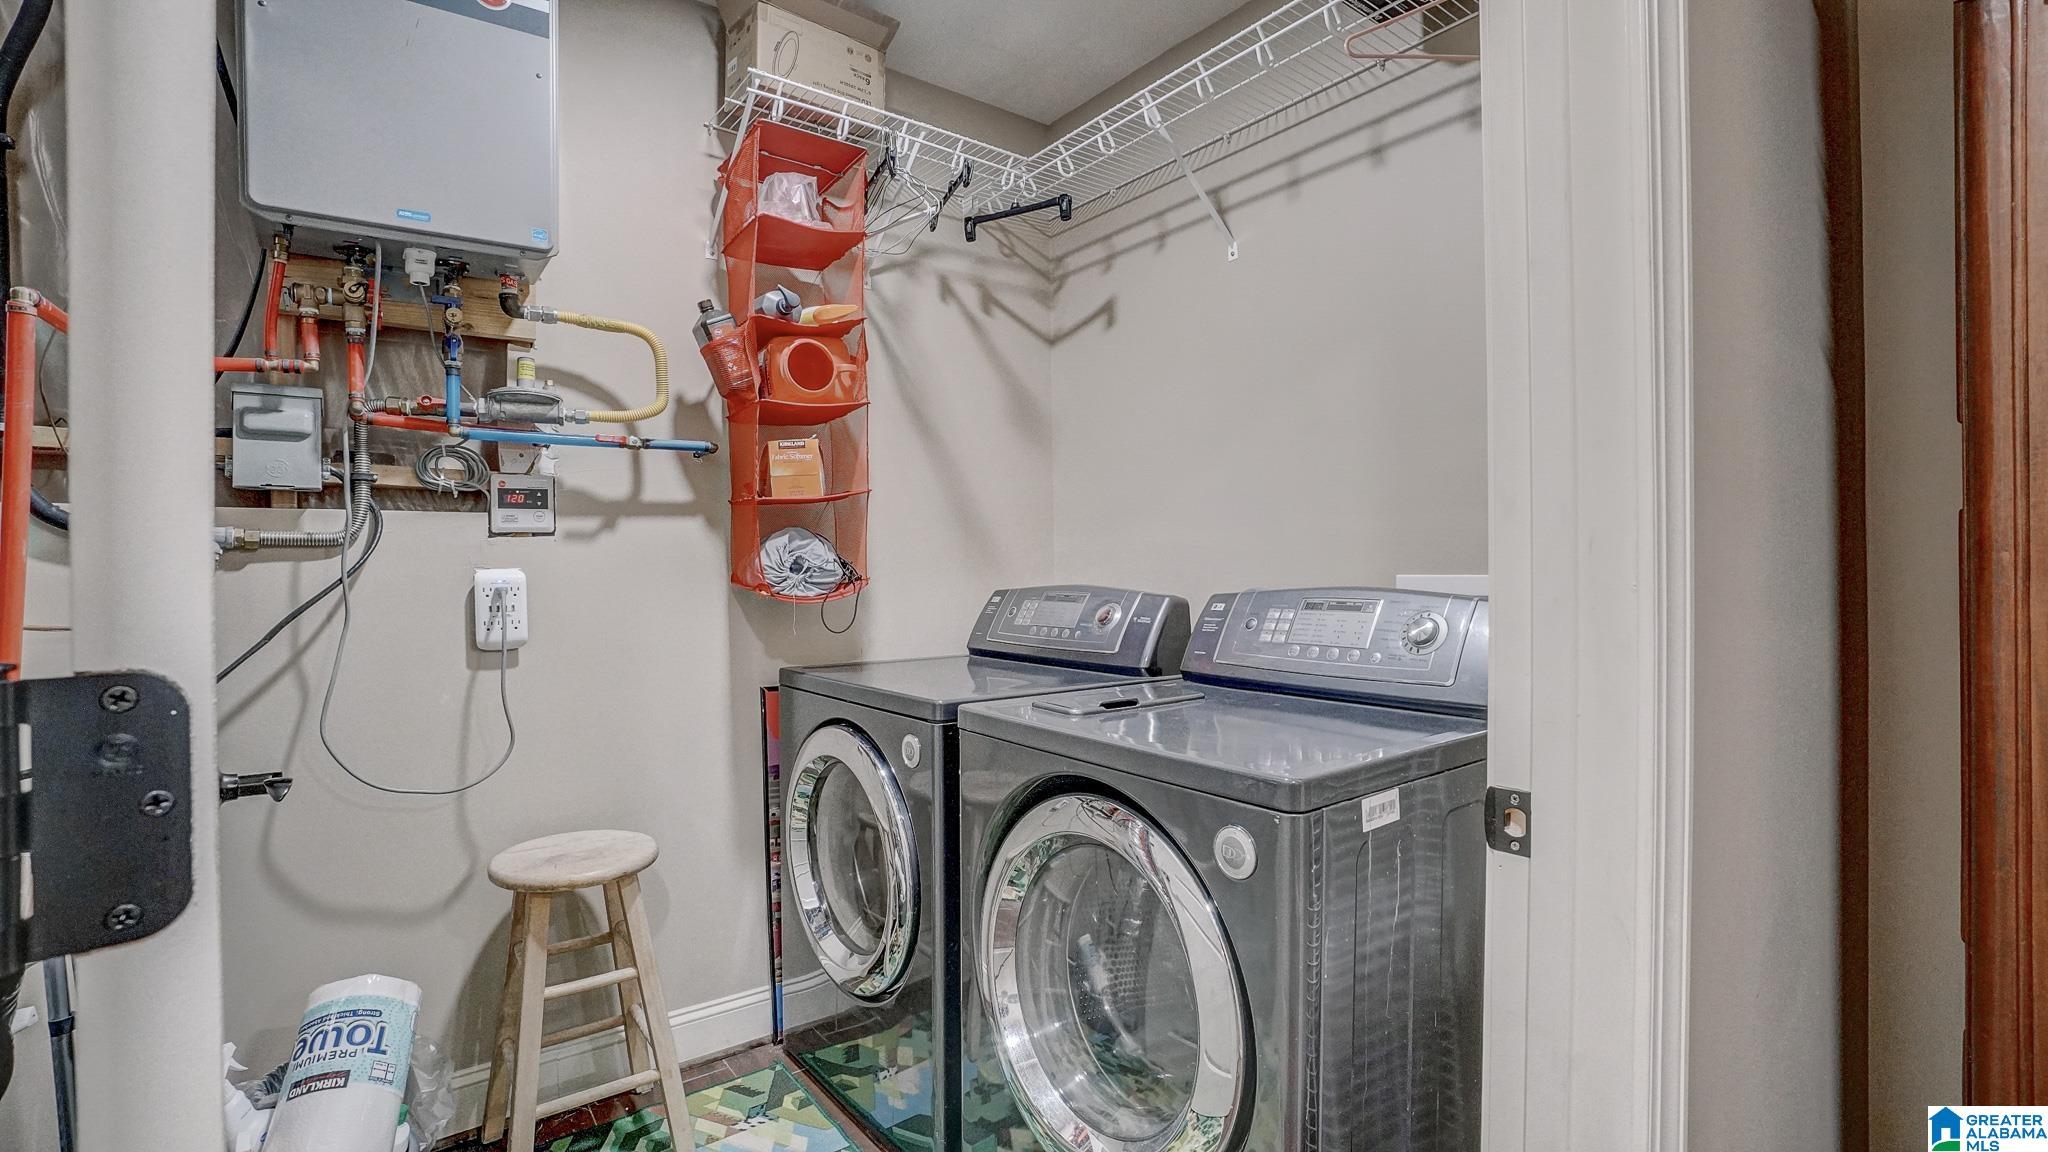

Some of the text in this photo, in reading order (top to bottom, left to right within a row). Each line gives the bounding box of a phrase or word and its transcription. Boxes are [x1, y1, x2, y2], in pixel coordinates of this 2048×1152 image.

[507, 494, 525, 503] 120
[292, 1023, 388, 1061] Towe
[295, 1047, 358, 1070] PREMIUM
[289, 1077, 346, 1099] KIRKLAND
